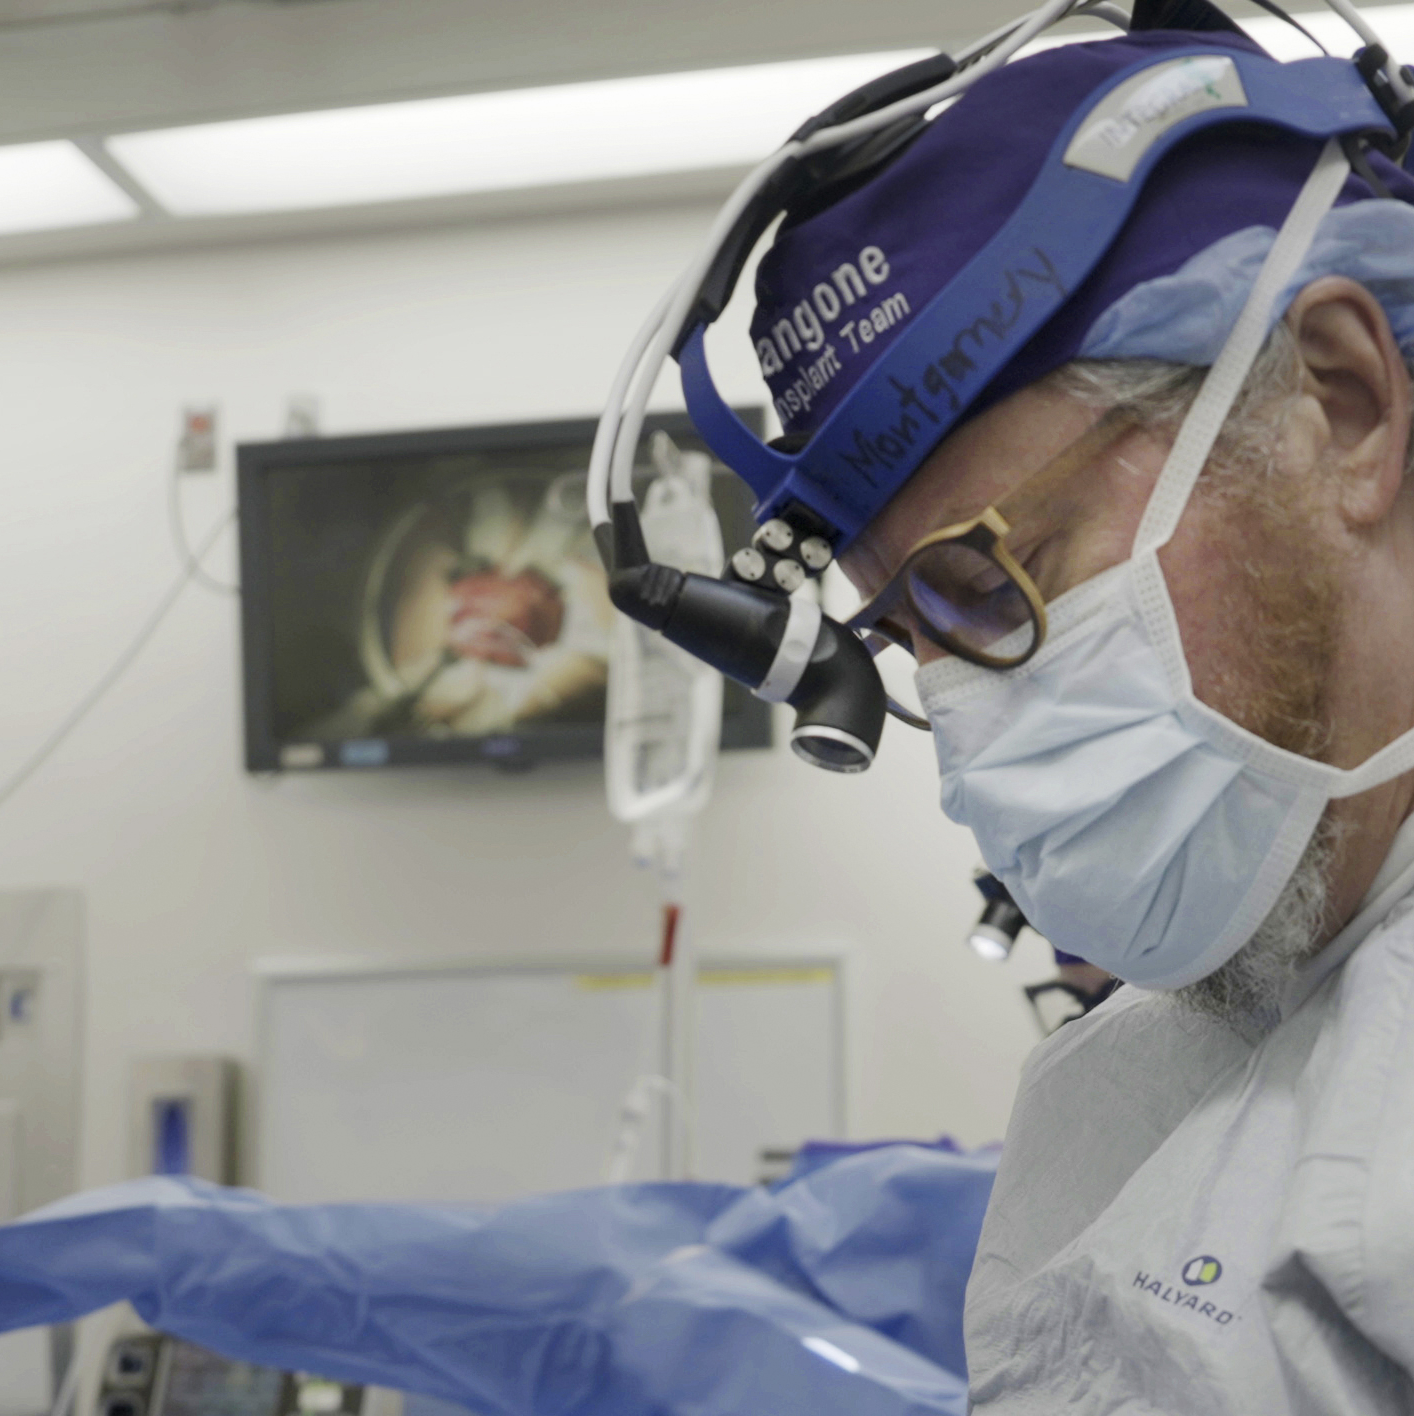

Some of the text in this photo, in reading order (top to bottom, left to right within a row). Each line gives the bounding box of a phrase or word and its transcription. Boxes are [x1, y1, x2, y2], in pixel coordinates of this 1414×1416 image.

[758, 246, 890, 377] angone
[774, 291, 911, 426] nsplant Team
[1132, 1270, 1234, 1325] HALYARD
